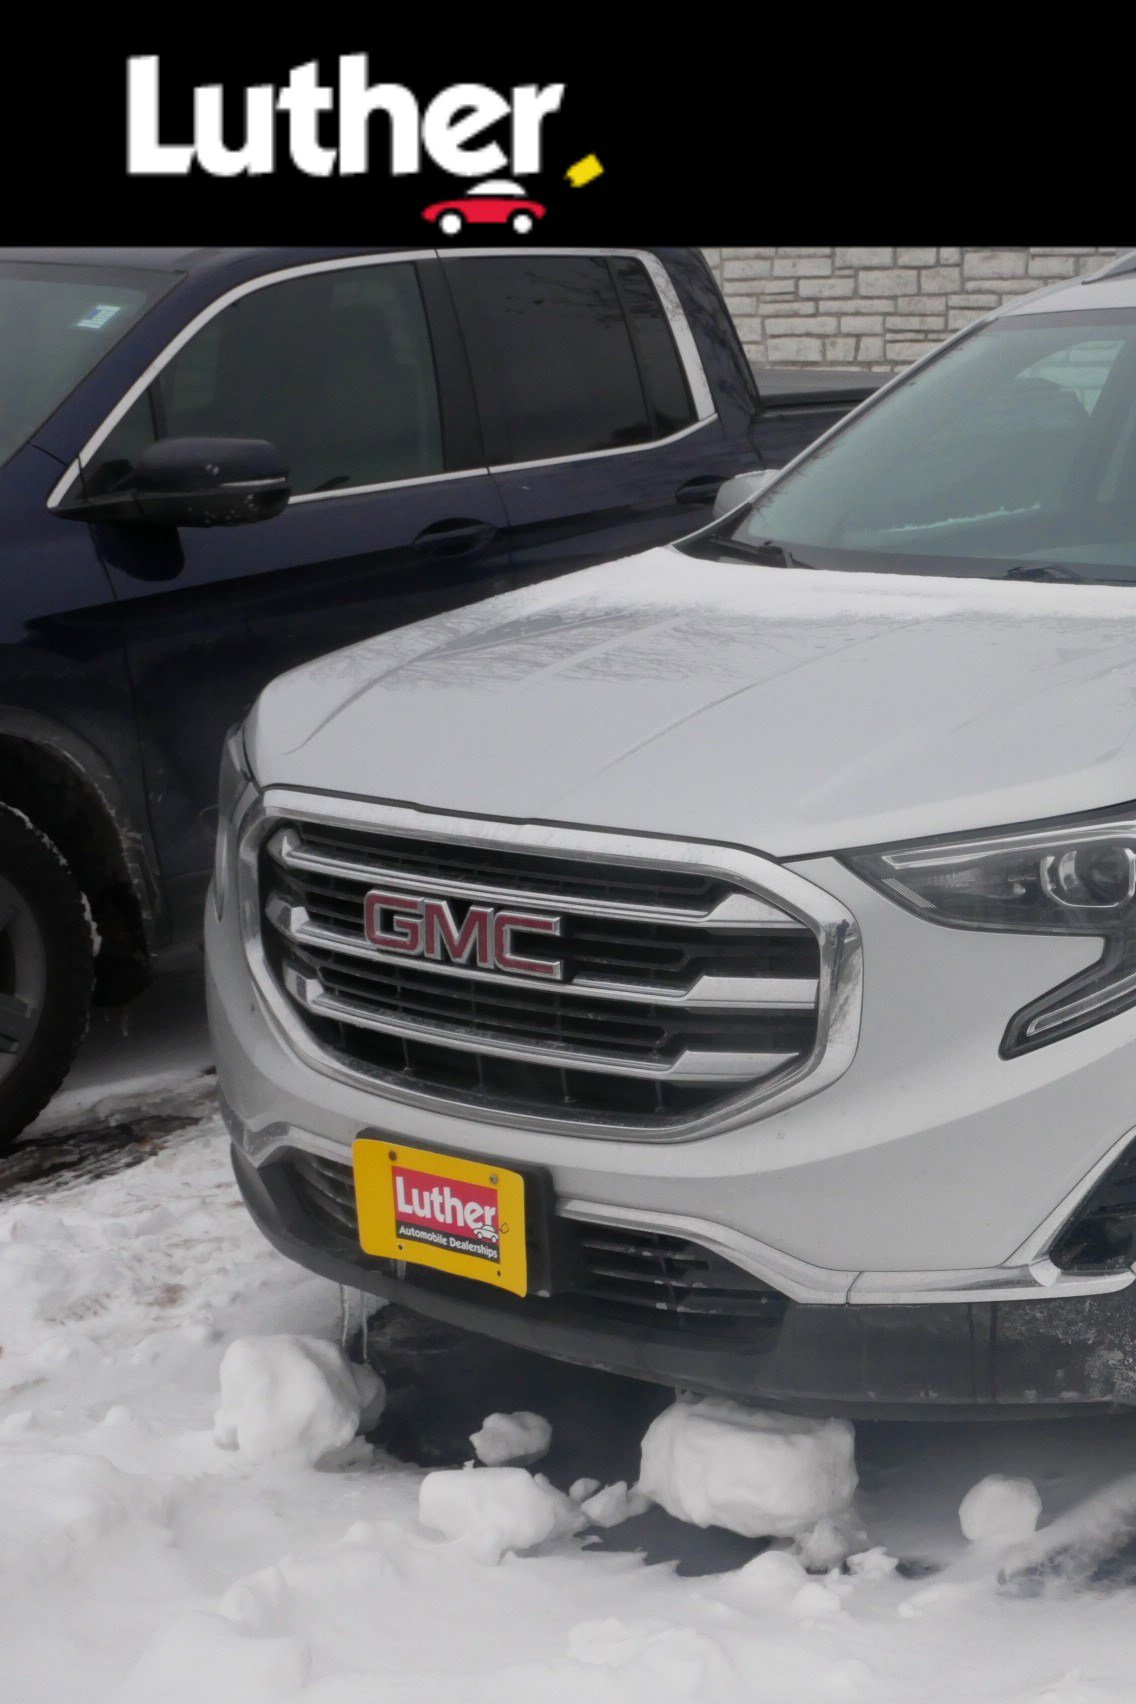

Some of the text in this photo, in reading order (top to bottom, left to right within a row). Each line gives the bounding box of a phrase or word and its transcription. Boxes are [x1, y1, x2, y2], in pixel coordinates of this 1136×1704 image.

[364, 888, 564, 980] GMC
[395, 1176, 496, 1227] Luther
[398, 1225, 498, 1259] Automobile Dealerships
